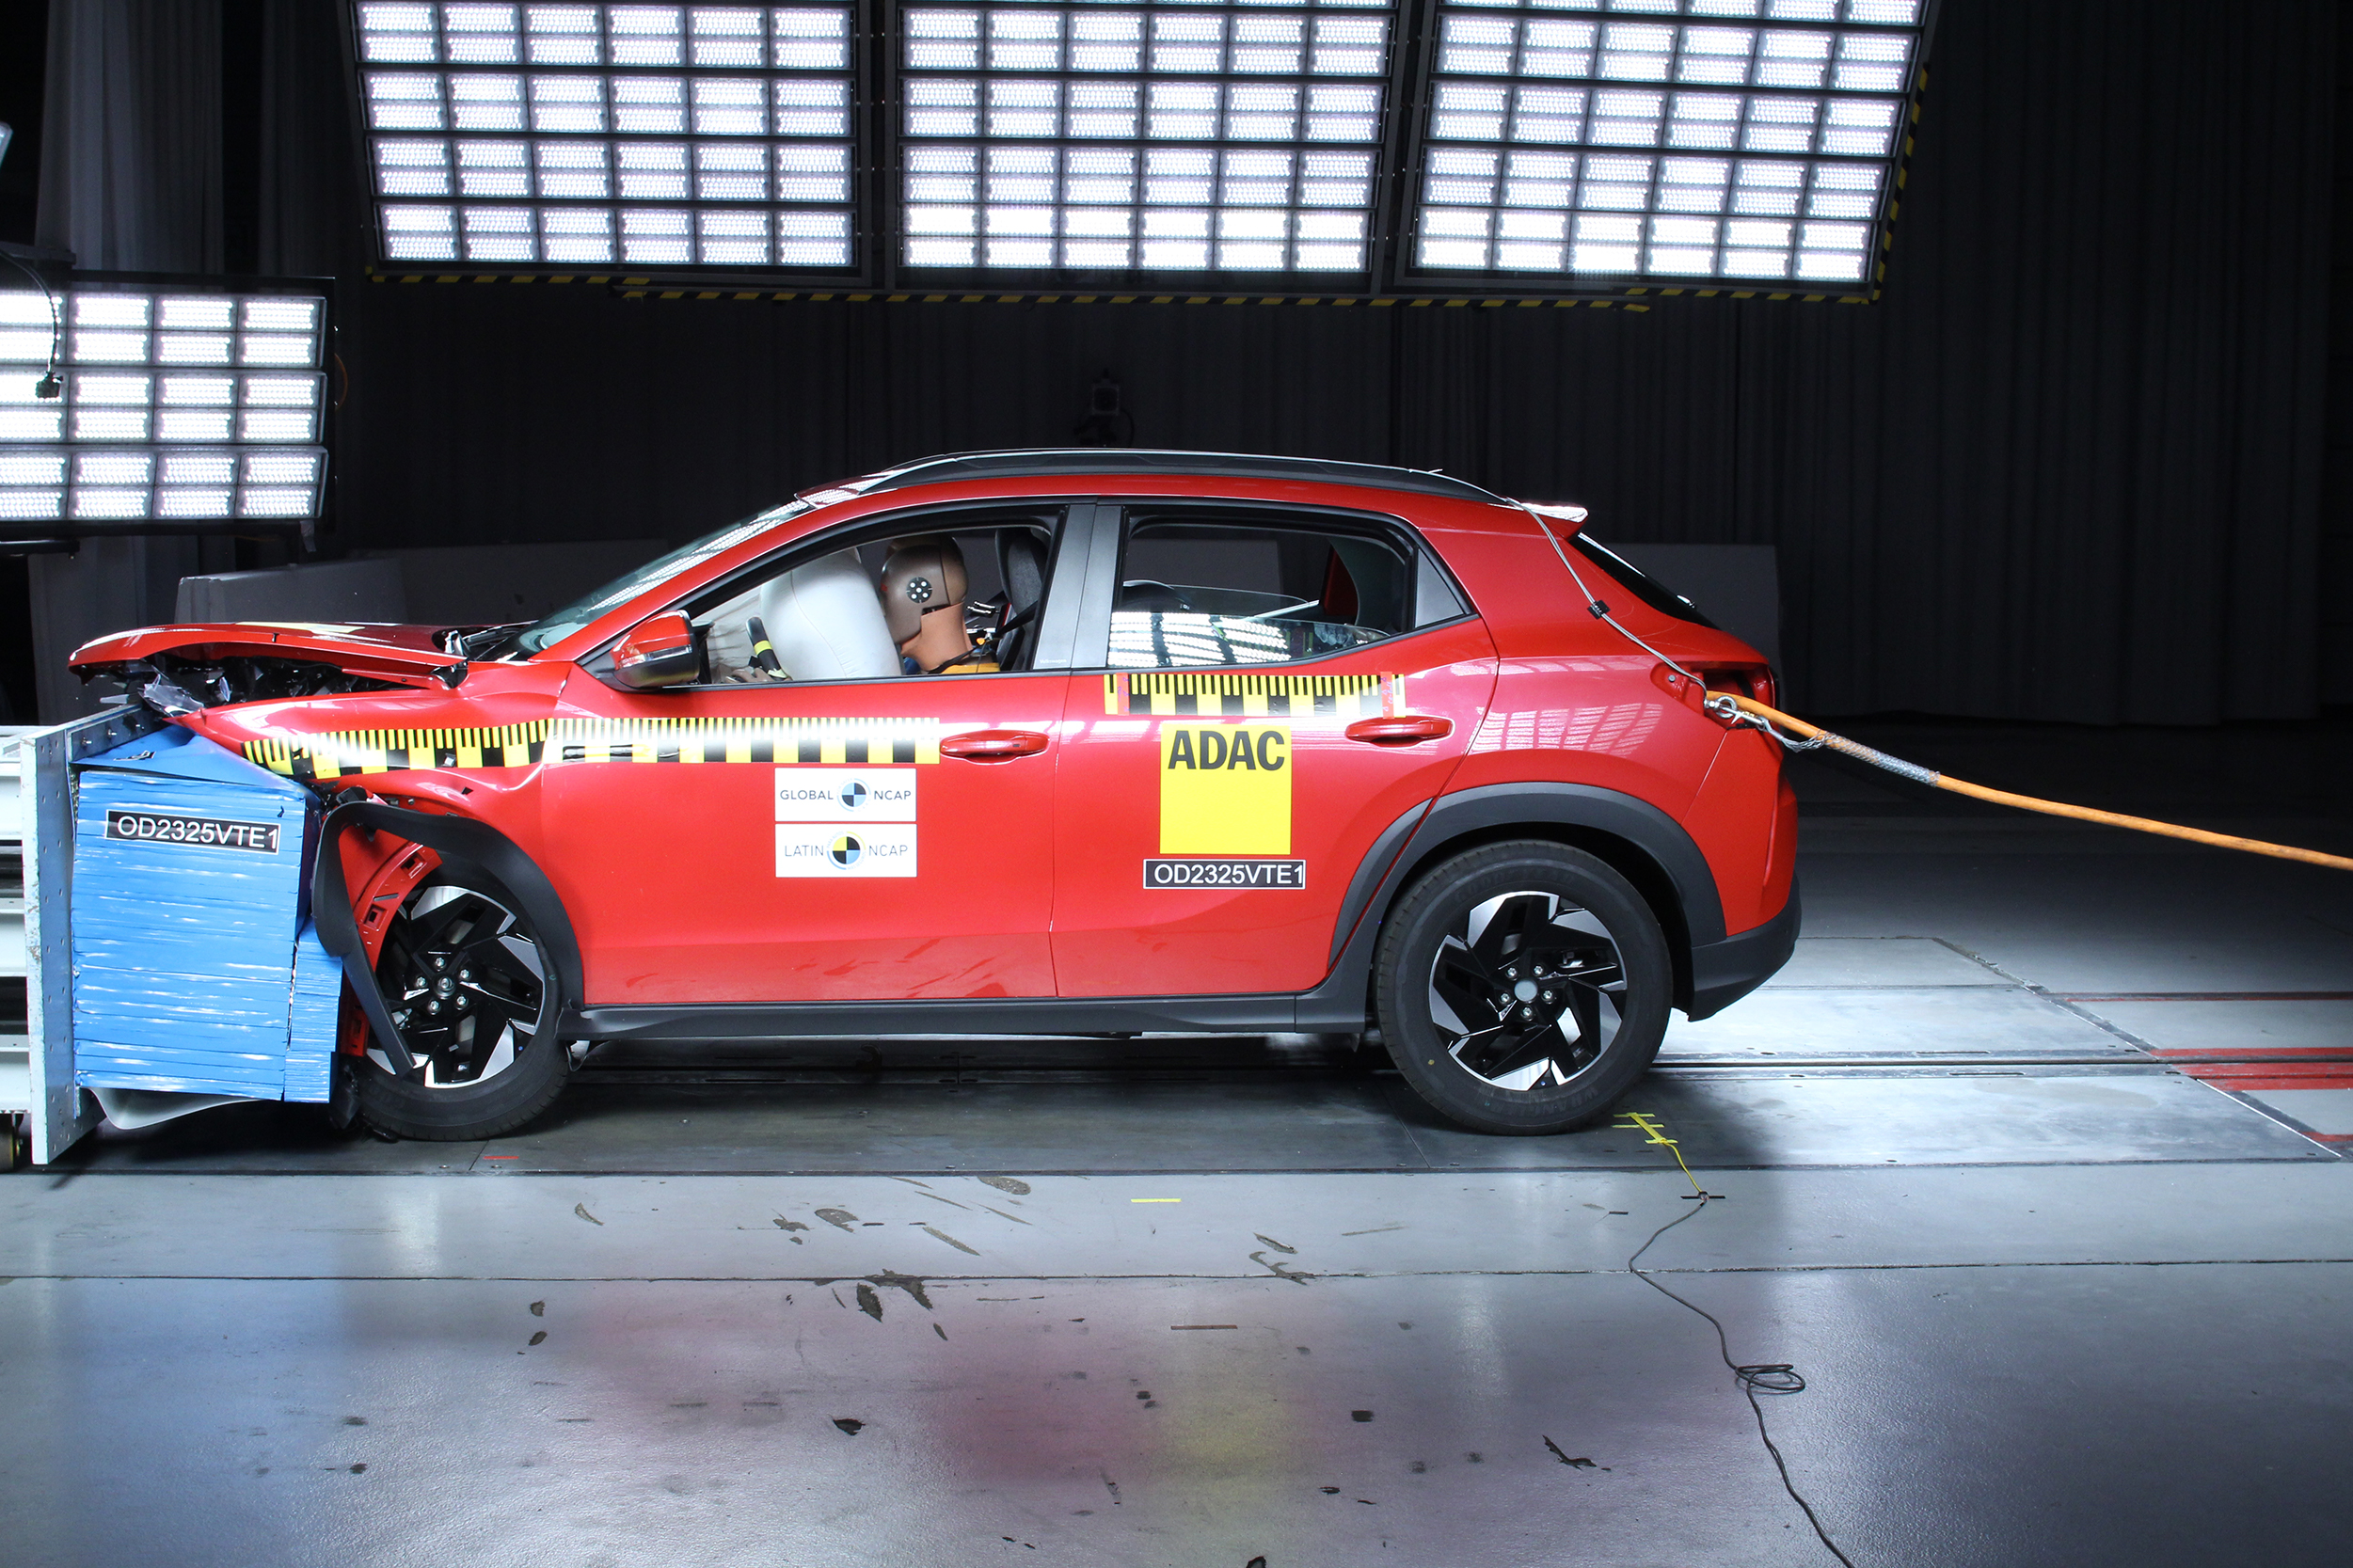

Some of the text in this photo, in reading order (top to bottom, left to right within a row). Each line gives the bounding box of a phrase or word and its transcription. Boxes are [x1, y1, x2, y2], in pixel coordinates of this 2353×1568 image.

[1168, 730, 1285, 771] ADAC
[780, 789, 912, 800] GLOBAL NCAP
[117, 816, 278, 849] OD2325VTE1
[784, 845, 908, 857] LATIN NCAP
[1153, 863, 1304, 885] OD2325VTE1
